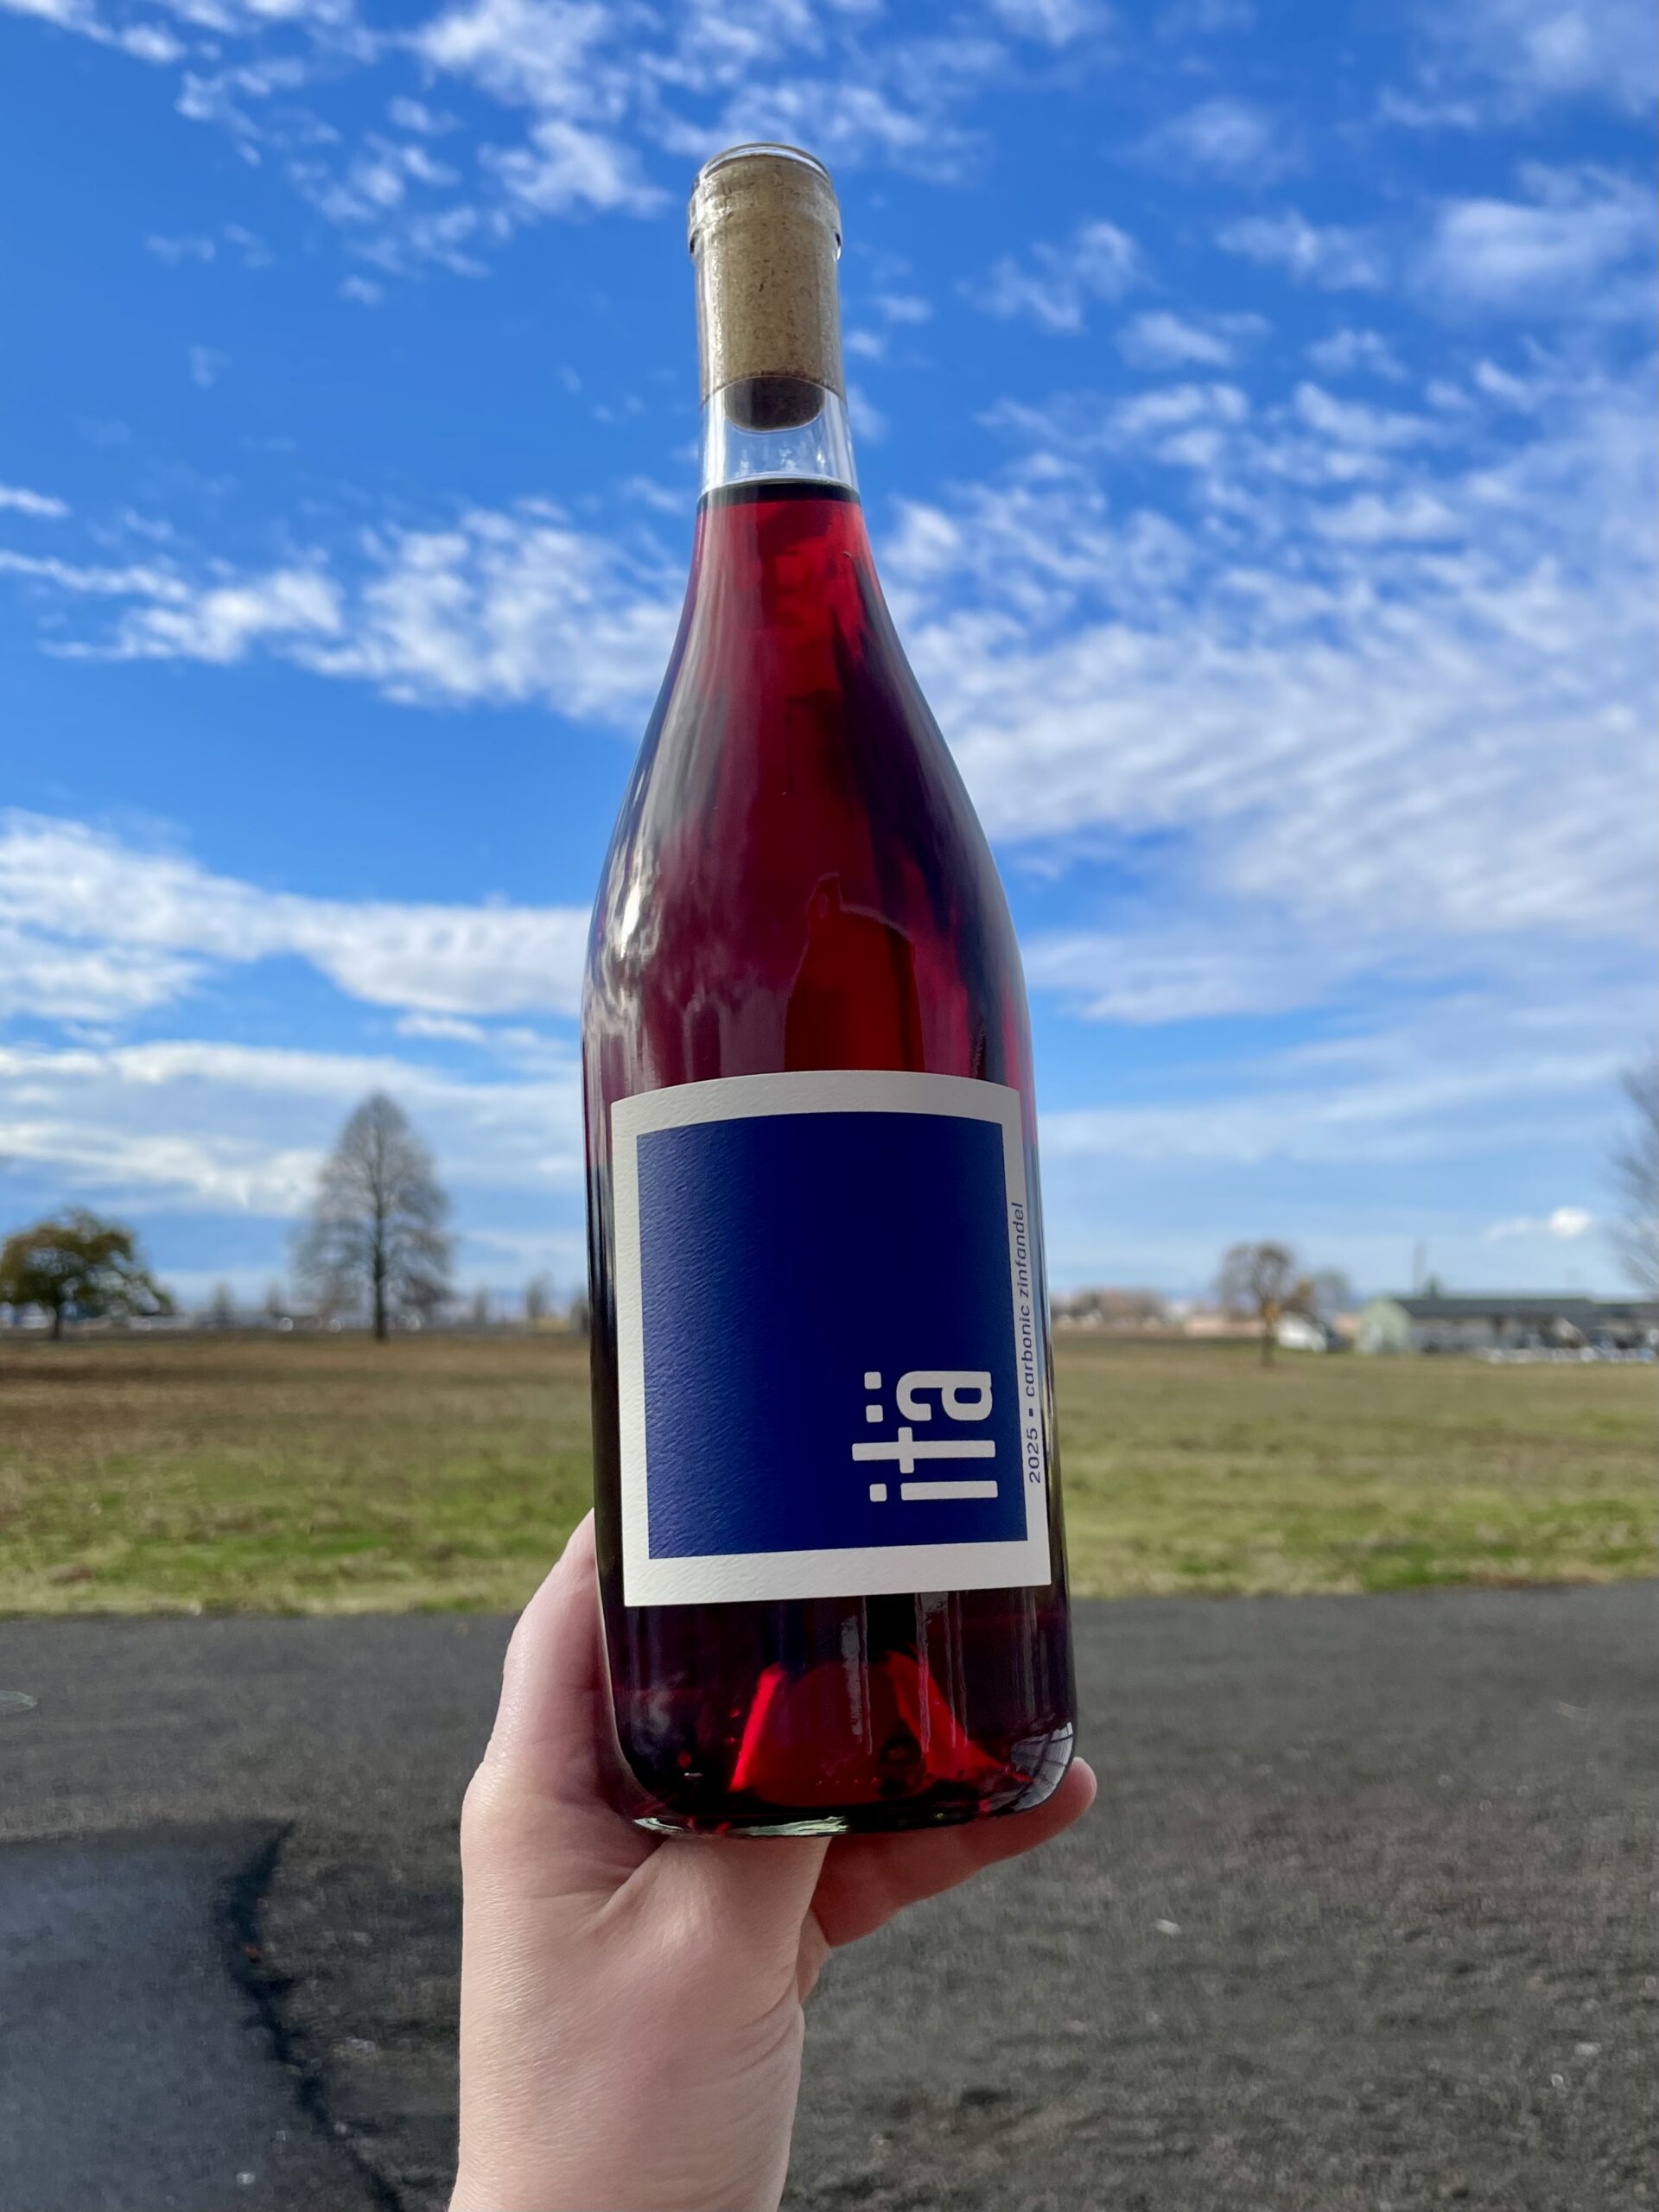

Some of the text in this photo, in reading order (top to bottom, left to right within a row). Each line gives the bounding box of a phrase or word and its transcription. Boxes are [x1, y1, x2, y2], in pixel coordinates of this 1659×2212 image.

[852, 1370, 998, 1502] itä
[1011, 1202, 1040, 1484] 2025 carbonic zinfandel
